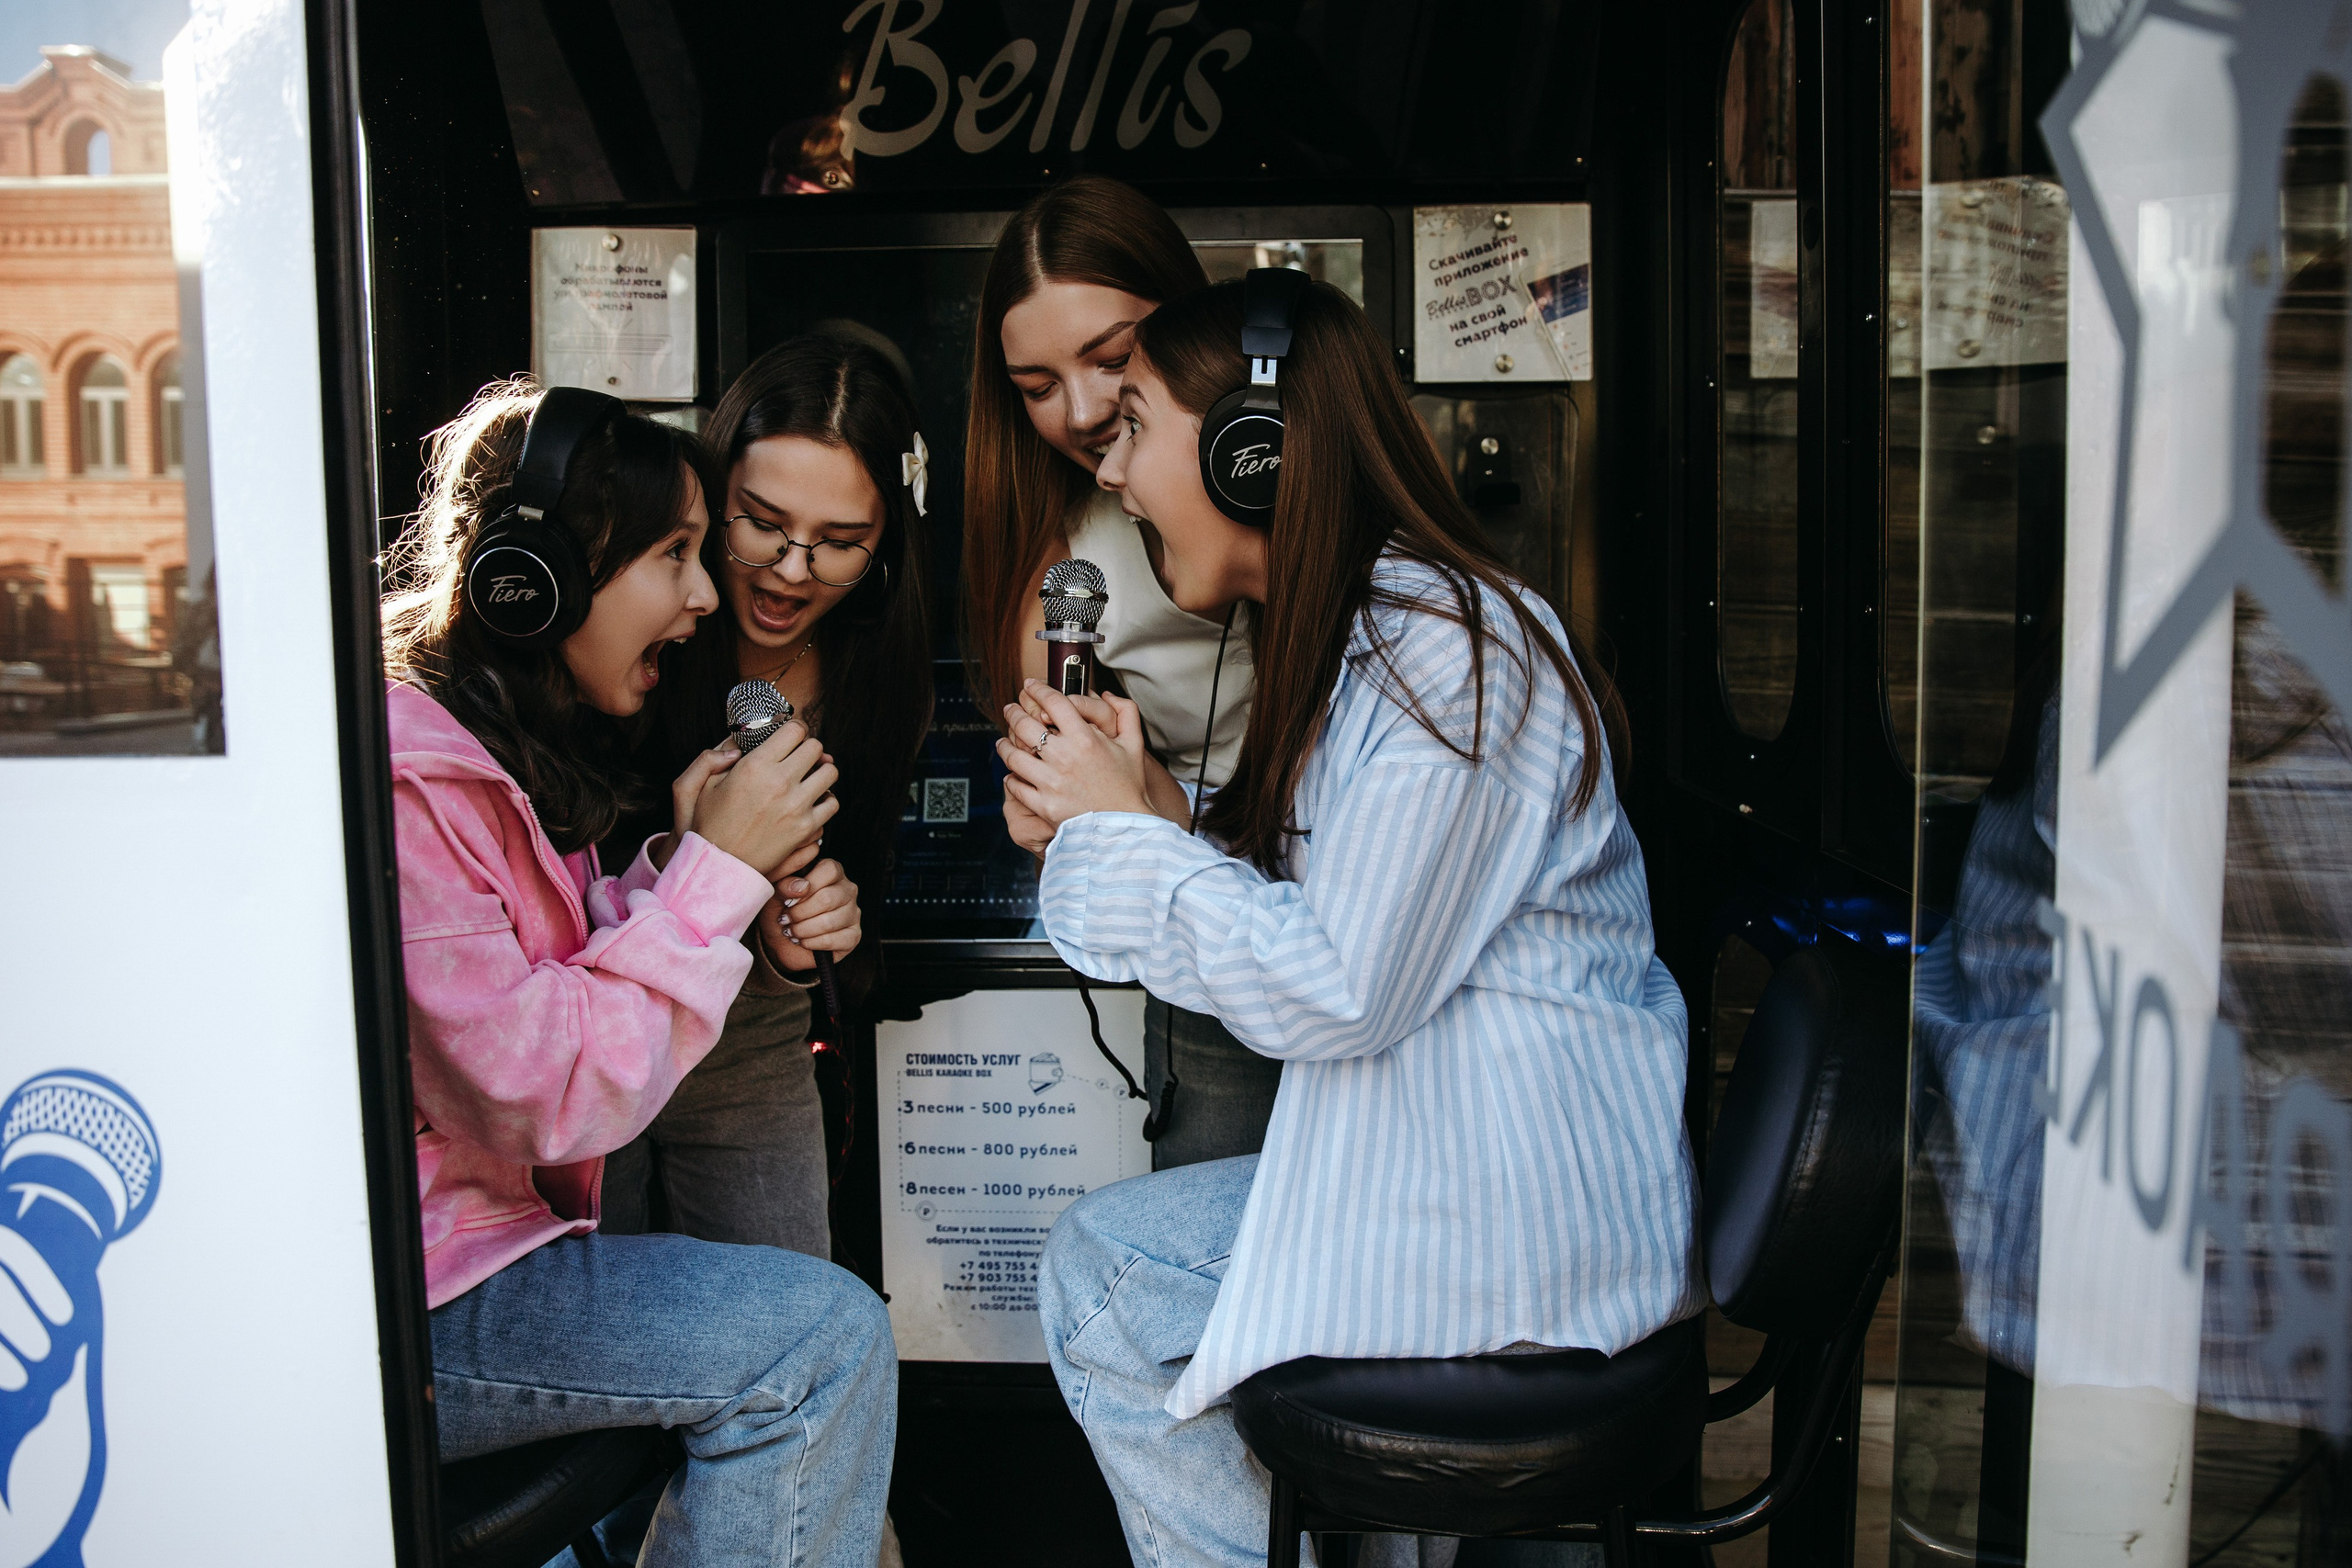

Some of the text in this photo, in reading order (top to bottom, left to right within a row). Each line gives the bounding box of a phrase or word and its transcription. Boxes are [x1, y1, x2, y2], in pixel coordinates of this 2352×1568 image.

[842, 0, 1252, 161] Bellis
[1429, 233, 1518, 271] Скачивайте
[1434, 247, 1530, 288] приложение
[1450, 303, 1507, 333] на свой
[1454, 316, 1528, 348] смартфон
[1231, 444, 1283, 479] Fiero
[489, 575, 539, 603] Fiero
[906, 1054, 1022, 1066] СТОИМОСТЬ УСЛУГ
[906, 1068, 992, 1077] BELLIS KARAOKE BOX
[903, 1100, 914, 1114] 3
[917, 1104, 965, 1114] песни
[982, 1102, 1012, 1114] 500
[1018, 1102, 1076, 1117] рублей
[904, 1142, 916, 1155] 6
[919, 1145, 966, 1155] песни
[983, 1143, 1014, 1156] 800
[1020, 1144, 1078, 1158] рублей
[906, 1181, 917, 1195] 8
[920, 1185, 966, 1195] песен
[983, 1183, 1023, 1196] 1000
[1027, 1184, 1085, 1199] рублей
[936, 1224, 959, 1233] Если
[961, 1226, 968, 1235] у
[926, 1236, 982, 1246] обратитесь
[959, 1260, 1039, 1270] +7 495 755 4
[959, 1272, 1038, 1282] +7 903 755 4
[979, 1284, 1016, 1292] работы
[979, 1303, 1006, 1311] 10:00
